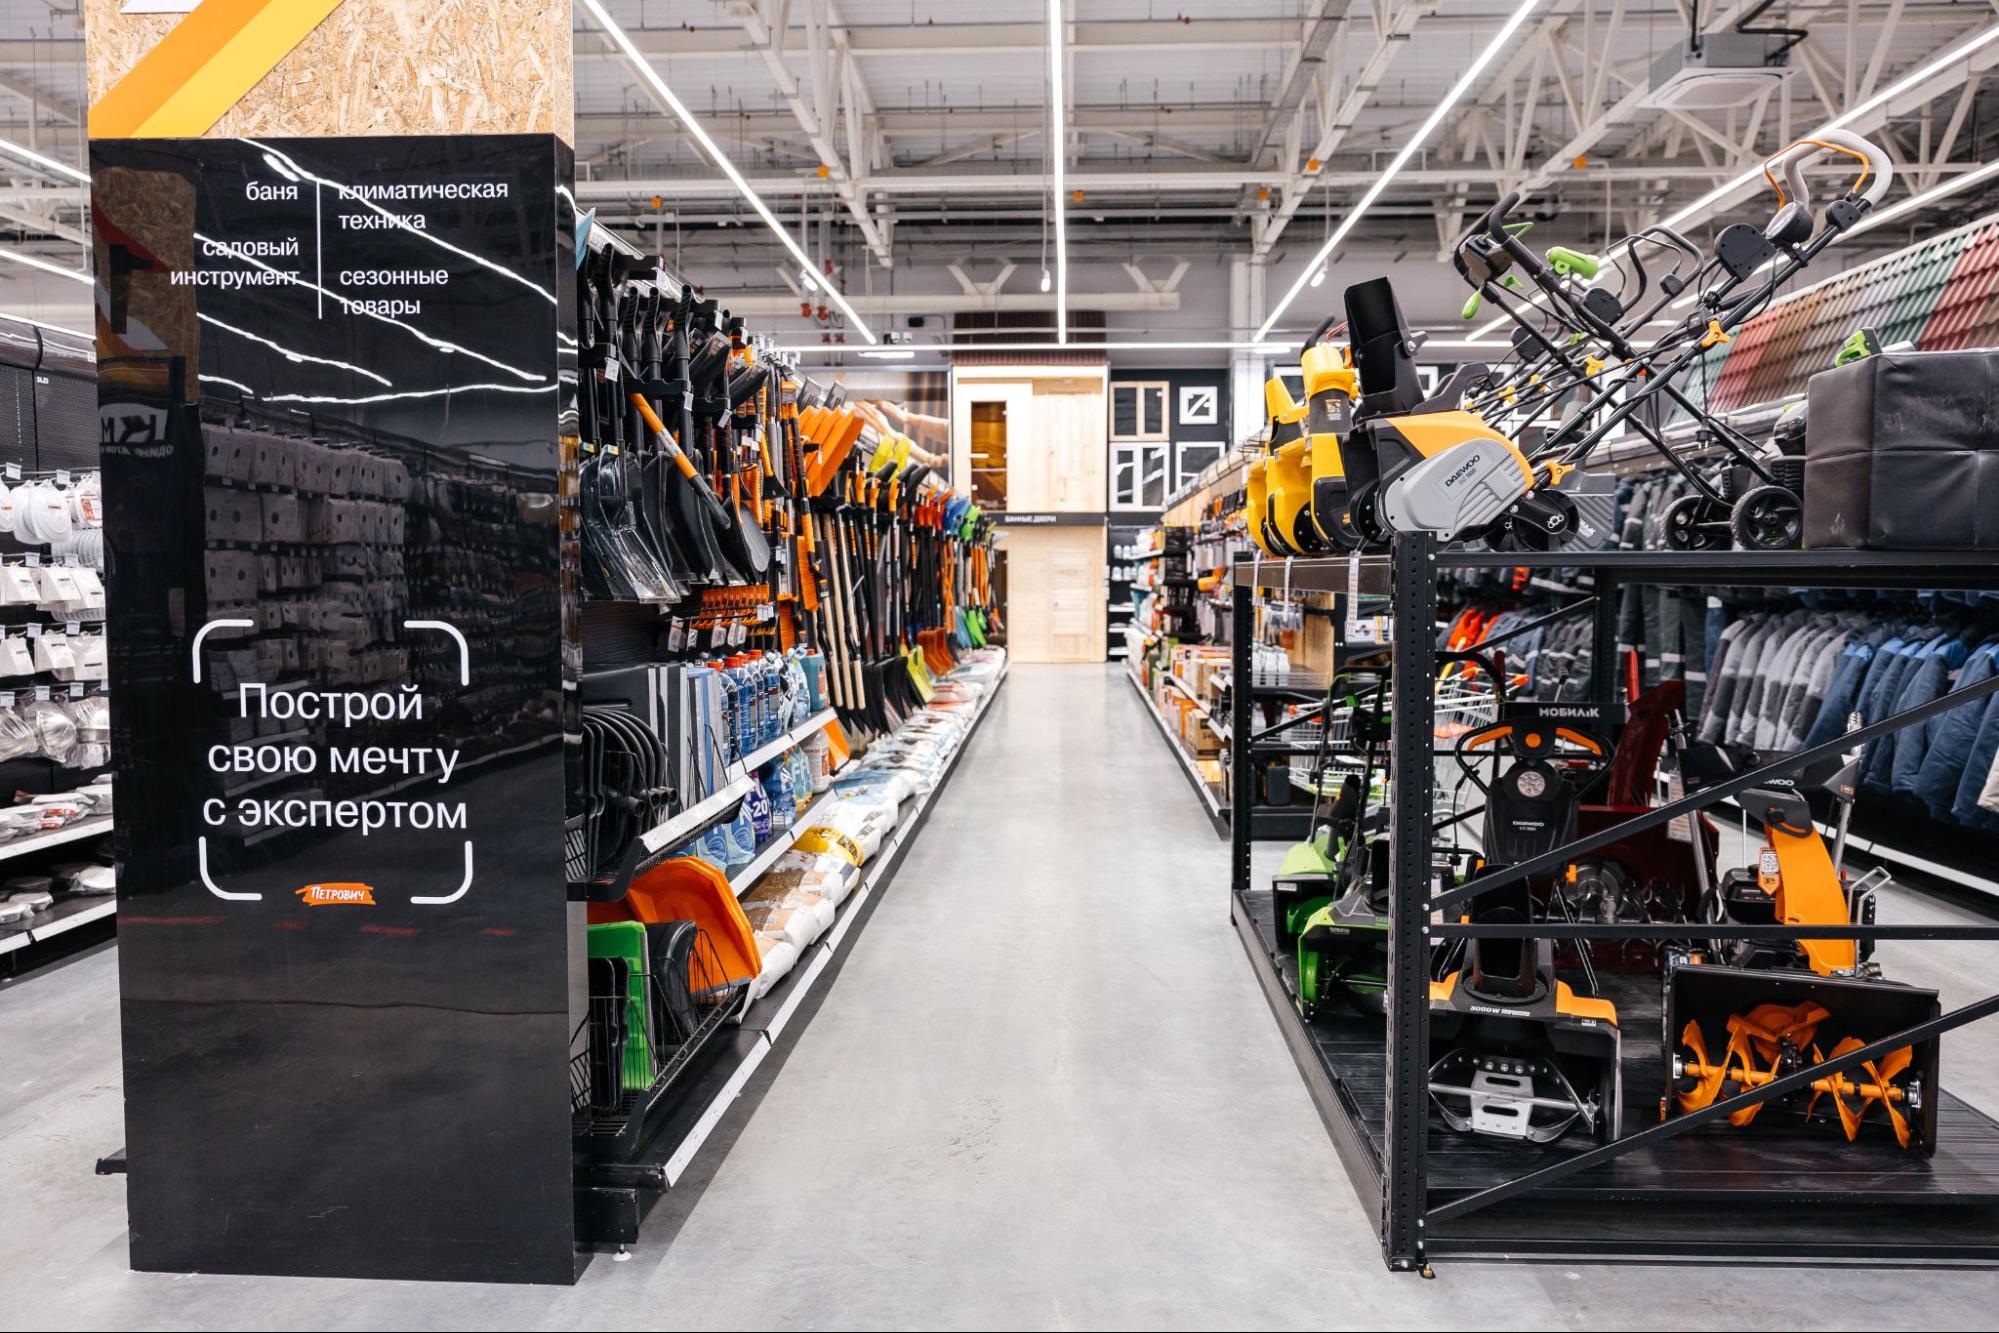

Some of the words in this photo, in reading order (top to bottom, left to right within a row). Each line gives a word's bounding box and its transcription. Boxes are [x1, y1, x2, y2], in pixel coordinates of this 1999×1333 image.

[246, 181, 299, 201] баня
[338, 183, 509, 200] климатическая
[338, 213, 427, 230] техника
[202, 237, 299, 259] садовый
[170, 270, 300, 290] инструмент
[339, 269, 449, 285] сезонные
[339, 299, 421, 319] товары
[1445, 455, 1481, 487] DAEWOO
[239, 682, 423, 727] Построй
[208, 744, 317, 773] свою
[330, 746, 460, 783] мечту
[203, 798, 226, 826] с
[238, 798, 467, 836] экспертом
